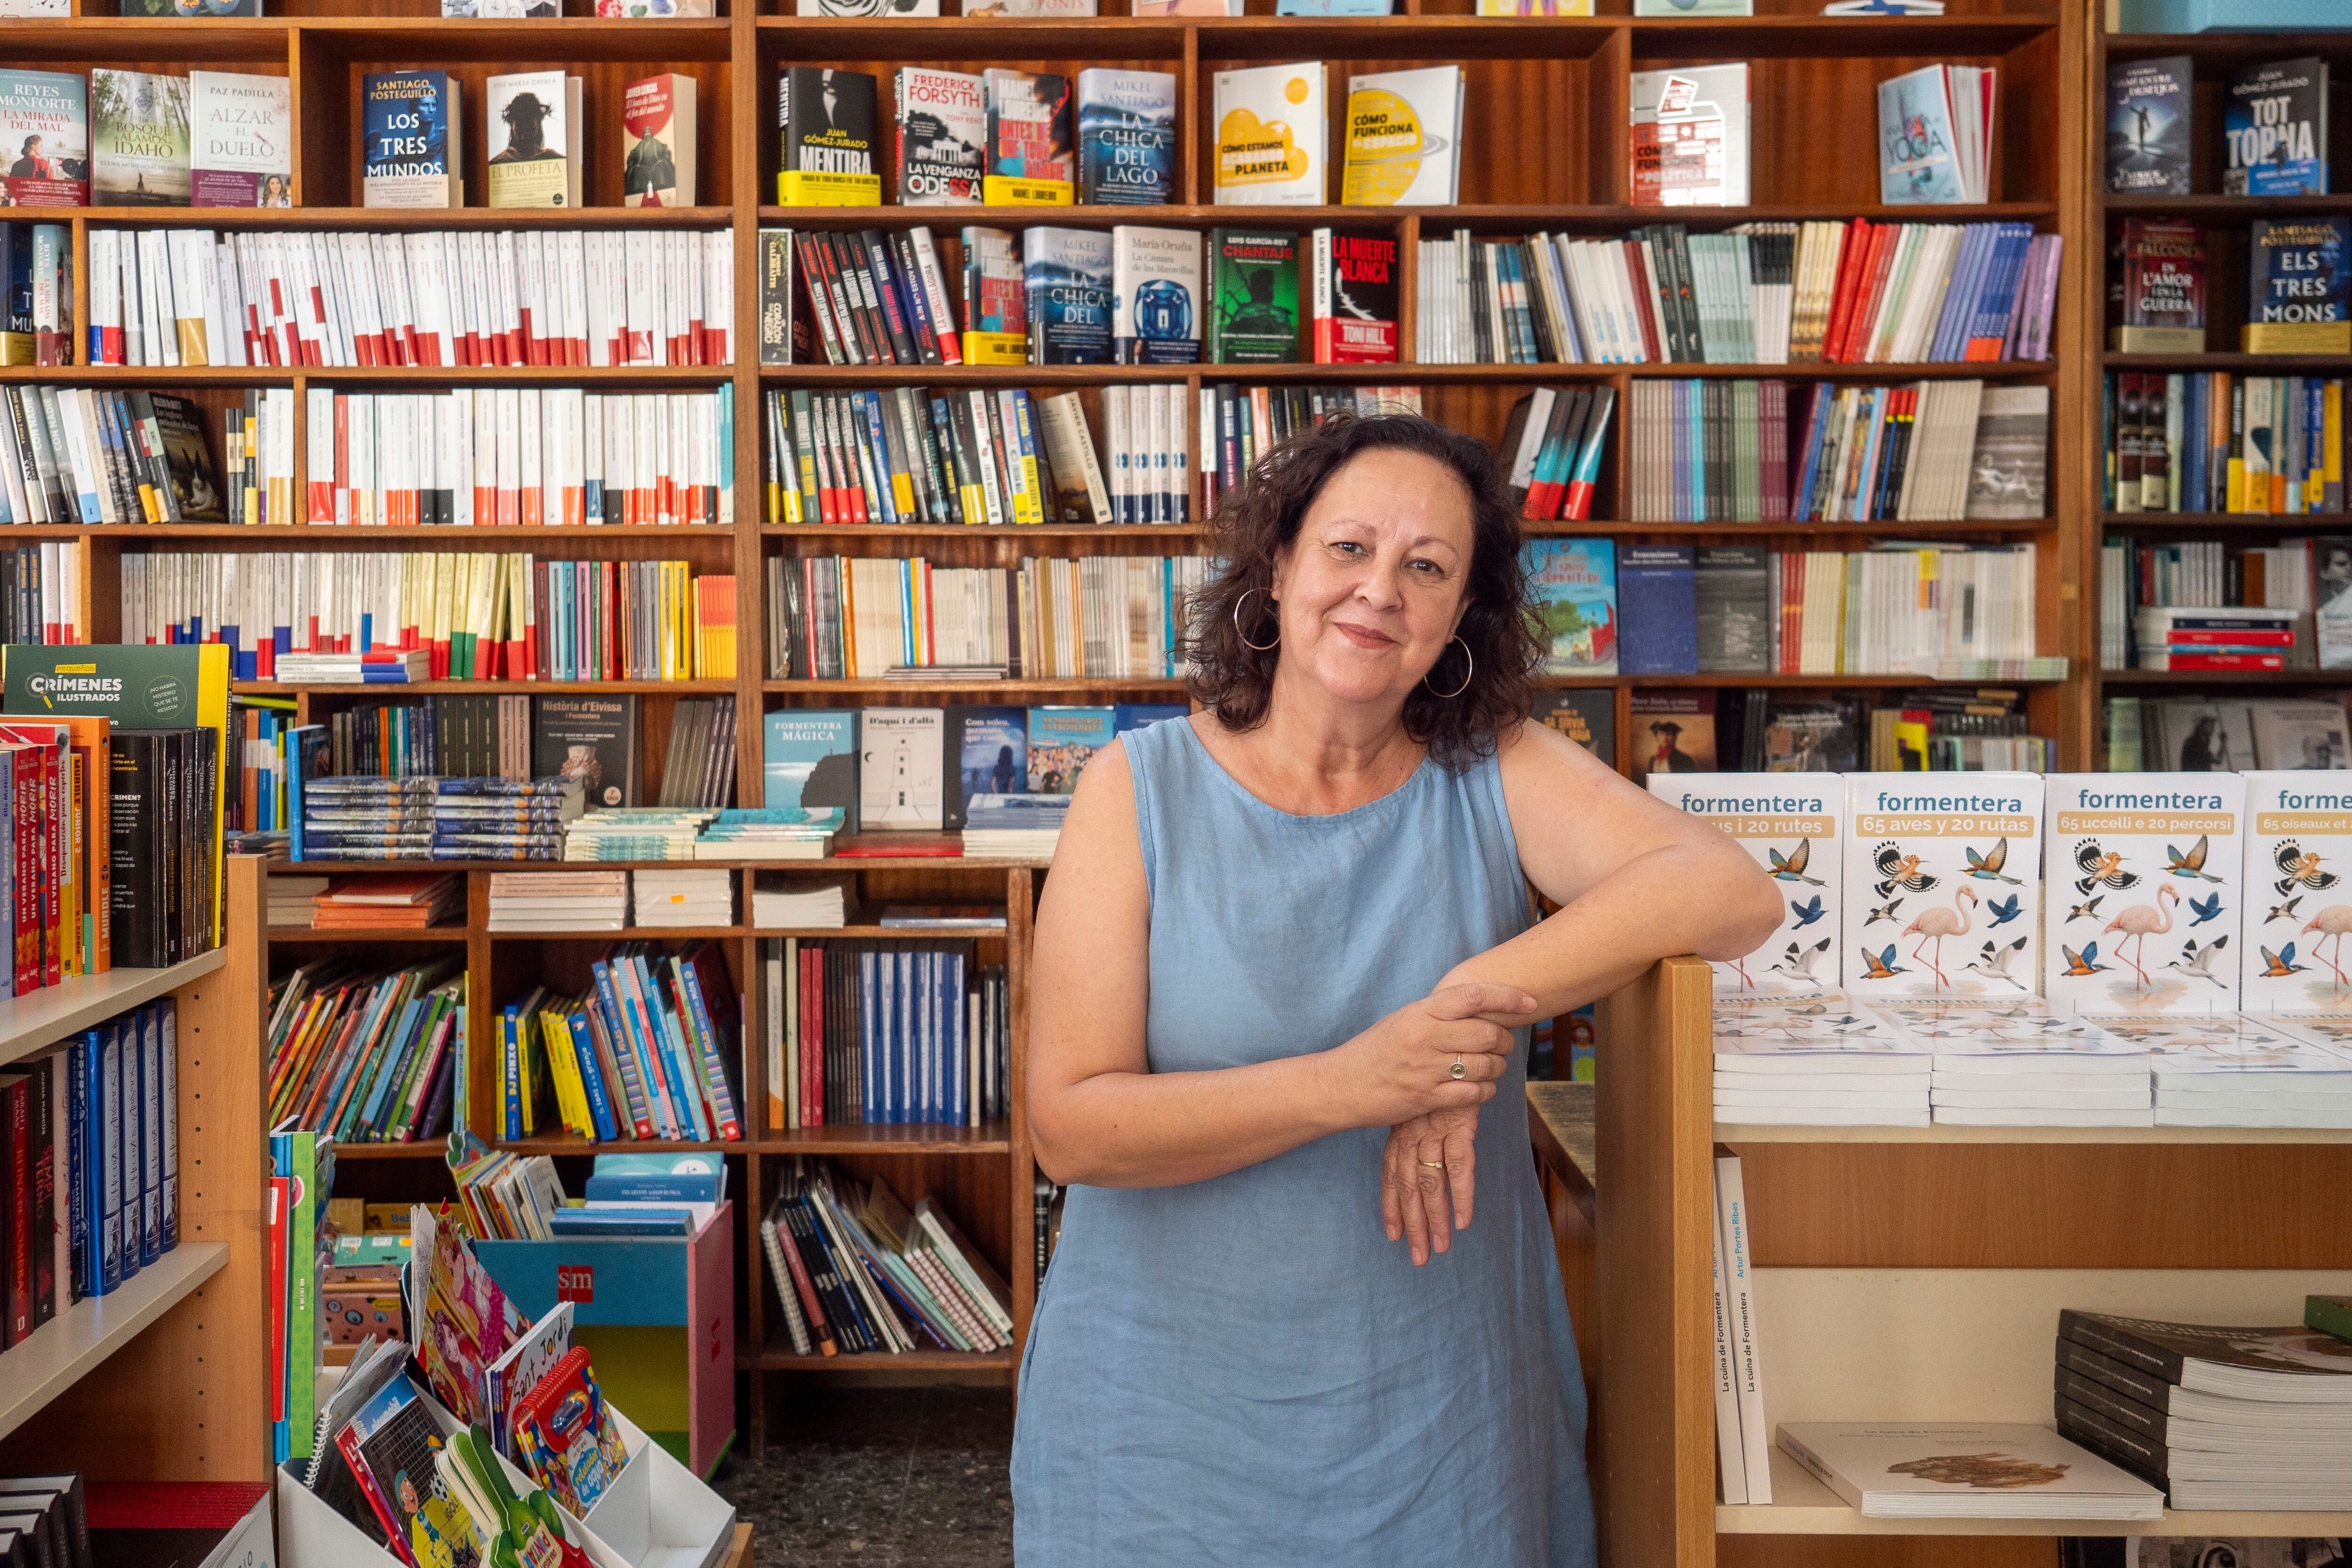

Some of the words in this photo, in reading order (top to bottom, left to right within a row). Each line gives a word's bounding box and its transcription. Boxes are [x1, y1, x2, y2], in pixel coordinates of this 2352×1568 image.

[15, 83, 59, 97] REYES
[376, 78, 430, 91] SANTIAGO
[531, 77, 557, 87] ZAVALA
[914, 75, 976, 89] FREDERICK
[1113, 80, 1152, 94] MIKEL
[210, 87, 228, 96] PAZ
[231, 88, 275, 98] PADILLA
[369, 88, 437, 101] POSTEGUILLO
[909, 86, 980, 108] FORSYTH
[1101, 93, 1165, 108] SANTIAGO
[0, 96, 76, 111] MONFORTE
[779, 76, 789, 128] MENTIRA
[4, 110, 18, 119] LA
[23, 111, 71, 123] MIRADA
[209, 108, 274, 126] ALZAR
[2249, 95, 2292, 127] TOT
[11, 120, 34, 131] DEL
[37, 121, 64, 133] MAL
[387, 112, 420, 130] LOS
[1122, 112, 1144, 130] LA
[1354, 113, 1388, 127] CÓMO
[236, 127, 249, 137] EL
[826, 127, 848, 137] JUAN
[1098, 128, 1164, 150] CHICA
[1353, 122, 1414, 139] FUNCIONA
[115, 141, 174, 158] IDAHO
[209, 139, 275, 159] DUELO
[380, 136, 428, 156] TRES
[803, 133, 868, 150] GÓMEZ-JURADO
[1222, 143, 1246, 154] CÓMO
[1247, 140, 1284, 152] ESTAMOS
[2225, 120, 2316, 168] TORNA
[799, 144, 872, 175] MENTIRA
[1114, 148, 1150, 167] DEL
[367, 161, 443, 178] MUNDOS
[493, 165, 504, 179] EL
[506, 161, 562, 179] PROFETA
[908, 162, 923, 175] LA
[923, 163, 981, 180] VENGANZA
[1106, 165, 1158, 185] LAGO
[1234, 161, 1289, 176] PLANETA
[908, 175, 982, 200] ODESSA
[2267, 224, 2335, 236] SANTIAGO
[1064, 239, 1097, 253] MIKEL
[1131, 238, 1158, 251] María
[1160, 238, 1193, 252] Oruña
[1227, 236, 1244, 245] LUIS
[1245, 237, 1290, 247] GARCÍA-REY
[1332, 236, 1348, 258] LA
[1349, 238, 1396, 263] MUERTE
[1051, 252, 1108, 267] SANTIAGO
[1131, 252, 1143, 263] La
[1145, 252, 1176, 264] Cámara
[1223, 244, 1294, 261] CHANTAJE
[768, 241, 777, 288] GALBRAITH
[1155, 264, 1195, 276] Maravillas
[2161, 262, 2176, 274] EN
[2281, 251, 2319, 272] ELS
[1070, 271, 1090, 288] LA
[1339, 259, 1390, 283] BLANCA
[2142, 271, 2193, 287] L'AMOR
[924, 264, 945, 318] CONSTELADORA
[2271, 277, 2328, 298] TRES
[1050, 287, 1108, 308] CHICA
[2139, 296, 2194, 313] GUERRA
[1064, 305, 1097, 325] DEL
[2262, 303, 2337, 323] MONS
[764, 311, 774, 344] NEGRO
[773, 302, 783, 344] CORAZÓN
[24, 396, 39, 427] NADIE
[44, 398, 59, 428] NADIE
[1069, 397, 1082, 427] JAVIER
[1078, 429, 1094, 470] CASTILLO
[56, 664, 95, 674] pequeños
[31, 675, 123, 692] CRÍMENES
[159, 682, 177, 693] HABRÁ
[56, 693, 120, 702] ILUSTRADOS
[152, 689, 177, 700] MISTERIO
[157, 704, 179, 714] RESISTA!
[542, 701, 580, 712] Història
[581, 701, 622, 712] d'Eivissa
[775, 722, 842, 731] FORMENTERA
[870, 716, 900, 726] D'aquí
[964, 718, 984, 727] Com
[782, 730, 835, 741] MÁGICA
[1681, 793, 1823, 813] formentera
[1877, 792, 2022, 813] formentera
[2078, 789, 2223, 810] formentera
[1747, 820, 1769, 834] 20
[1774, 819, 1822, 834] rutes
[1862, 817, 1885, 835] 65
[1890, 817, 1932, 832] aves
[1936, 820, 1948, 836] y
[1951, 818, 1975, 832] 20
[1979, 818, 2029, 832] rutas
[2060, 816, 2079, 830] 65
[2082, 815, 2132, 829] uccelli
[2135, 819, 2145, 830] e
[2149, 819, 2167, 829] 20
[2170, 816, 2232, 833] percorsi
[2263, 819, 2279, 831] 65
[2281, 818, 2331, 829] oiseaux
[2334, 818, 2347, 829] et
[22, 908, 27, 923] UN
[31, 903, 36, 919] UN
[51, 900, 57, 915] UN
[1879, 997, 2022, 1006] formentera
[508, 1043, 516, 1076] PINXO
[509, 1079, 517, 1097] DJ
[16, 1219, 24, 1299] SOMBRAS
[558, 1271, 592, 1290] sm
[1714, 1292, 1724, 1342] Formentera
[1740, 1292, 1750, 1342] Formentera
[540, 1316, 567, 1365] Jordi
[1718, 1343, 1726, 1356] de
[1744, 1343, 1751, 1356] de
[513, 1357, 536, 1402] Sant
[1723, 1381, 1730, 1392] La
[1748, 1381, 1755, 1392] La
[574, 1449, 599, 1486] rotulador
[587, 1462, 604, 1490] agua
